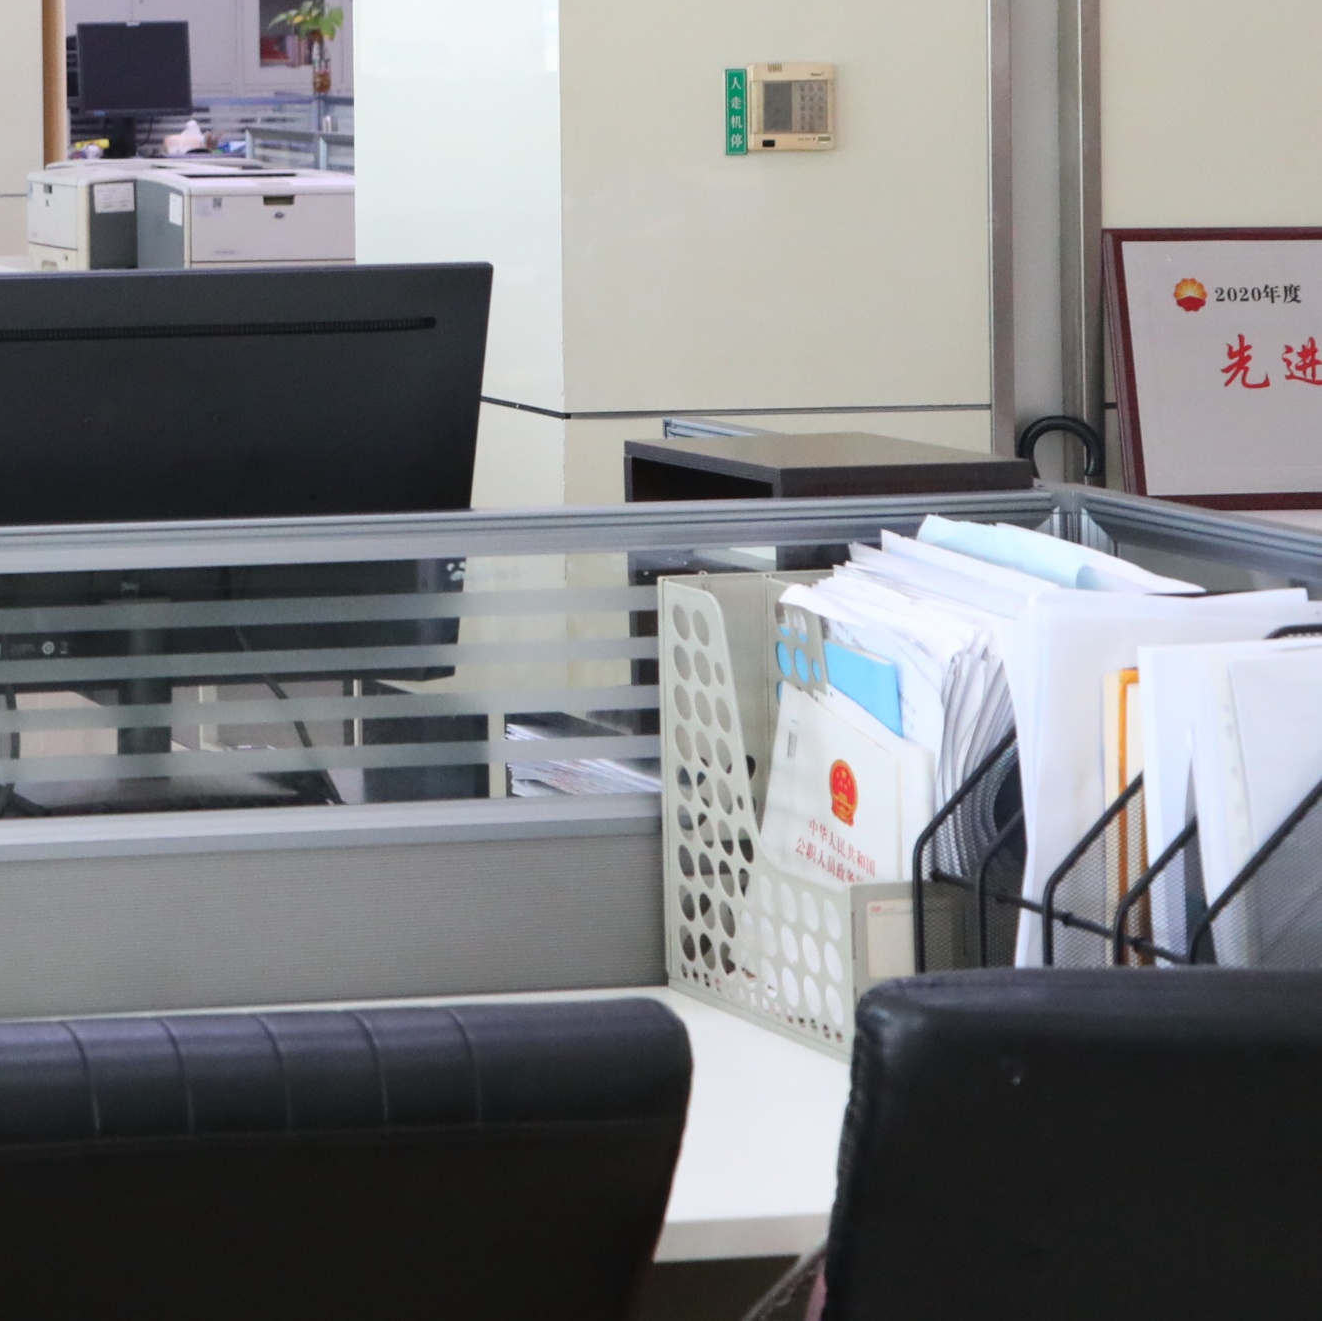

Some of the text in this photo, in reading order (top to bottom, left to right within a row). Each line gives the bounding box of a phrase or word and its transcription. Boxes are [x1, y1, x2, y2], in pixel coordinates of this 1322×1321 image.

[730, 76, 743, 148] 人走机停
[1215, 284, 1302, 304] 2020年度
[795, 837, 864, 882] 公职人员政务
[808, 818, 877, 879] 中华人民共和国
